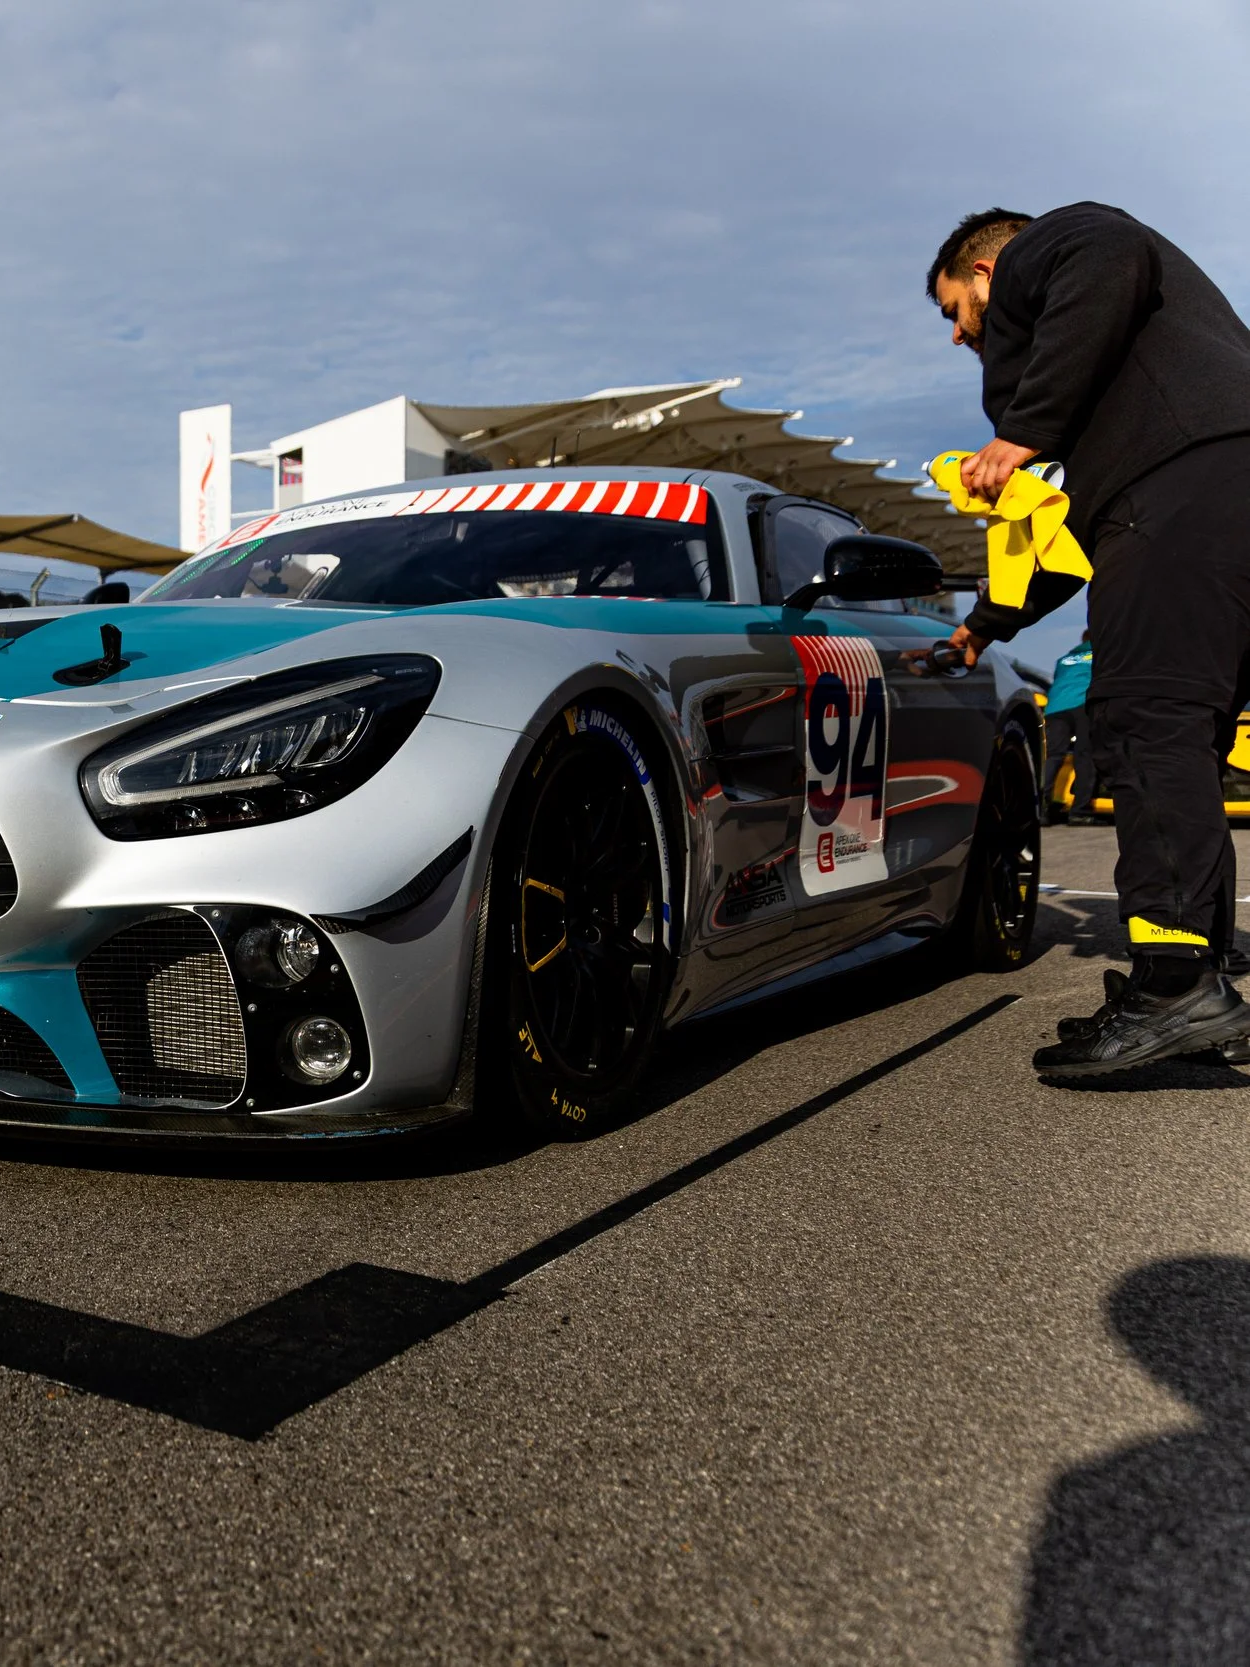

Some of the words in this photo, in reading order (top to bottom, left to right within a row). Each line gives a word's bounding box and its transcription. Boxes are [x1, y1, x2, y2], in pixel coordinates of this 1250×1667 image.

[588, 709, 647, 776] MICHELIN
[807, 671, 886, 827] 94
[834, 843, 869, 858] ENDURANCE
[561, 1099, 586, 1122] COTA
